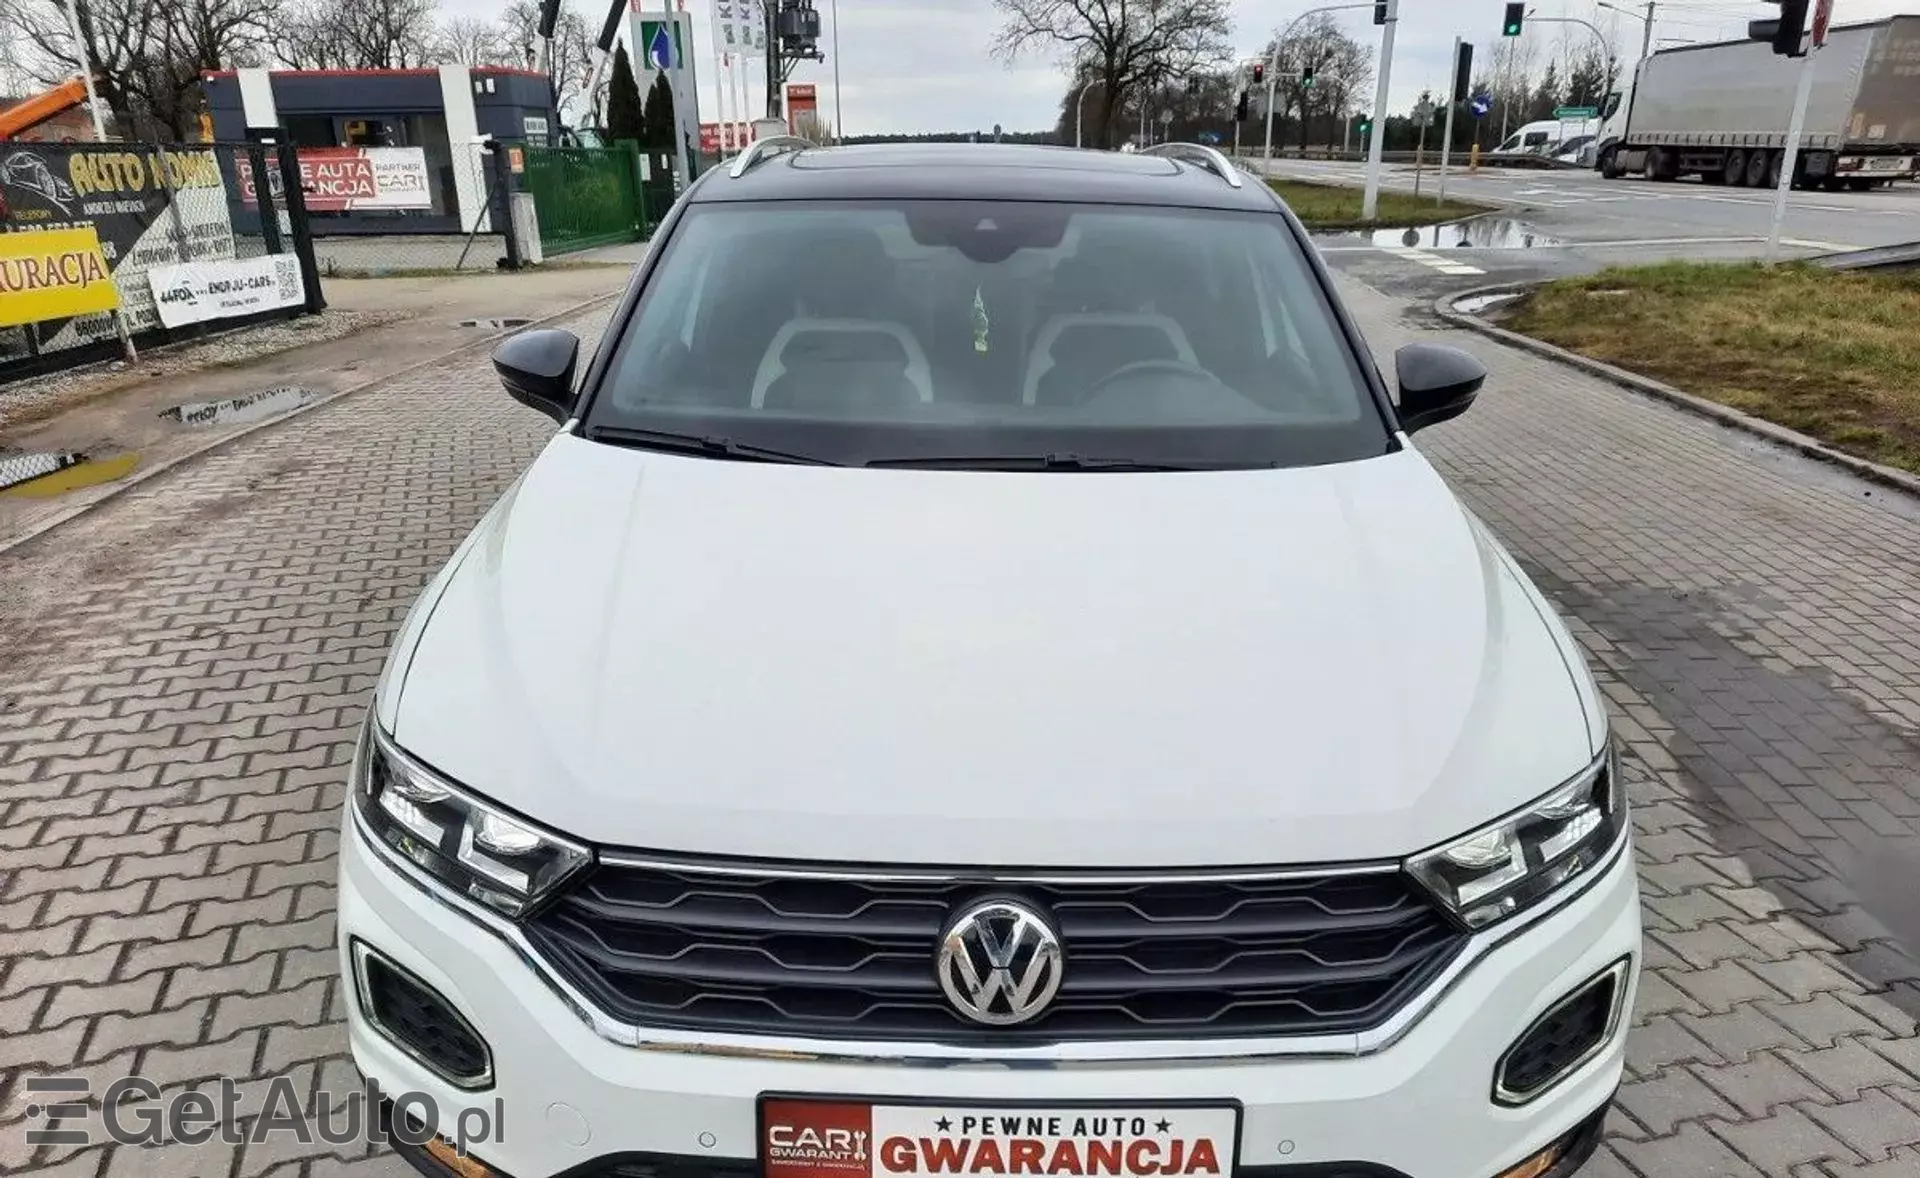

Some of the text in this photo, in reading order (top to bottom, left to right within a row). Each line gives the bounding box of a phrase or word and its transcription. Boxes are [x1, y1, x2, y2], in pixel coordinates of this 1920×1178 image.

[69, 151, 145, 197] AUTO
[316, 153, 371, 178] AUTA
[377, 174, 418, 187] CAR
[769, 1126, 851, 1149] CAR
[962, 1116, 1146, 1136] PEWNE AUTO
[769, 1147, 852, 1160] GWARANT
[880, 1136, 1221, 1176] GWARANCJA
